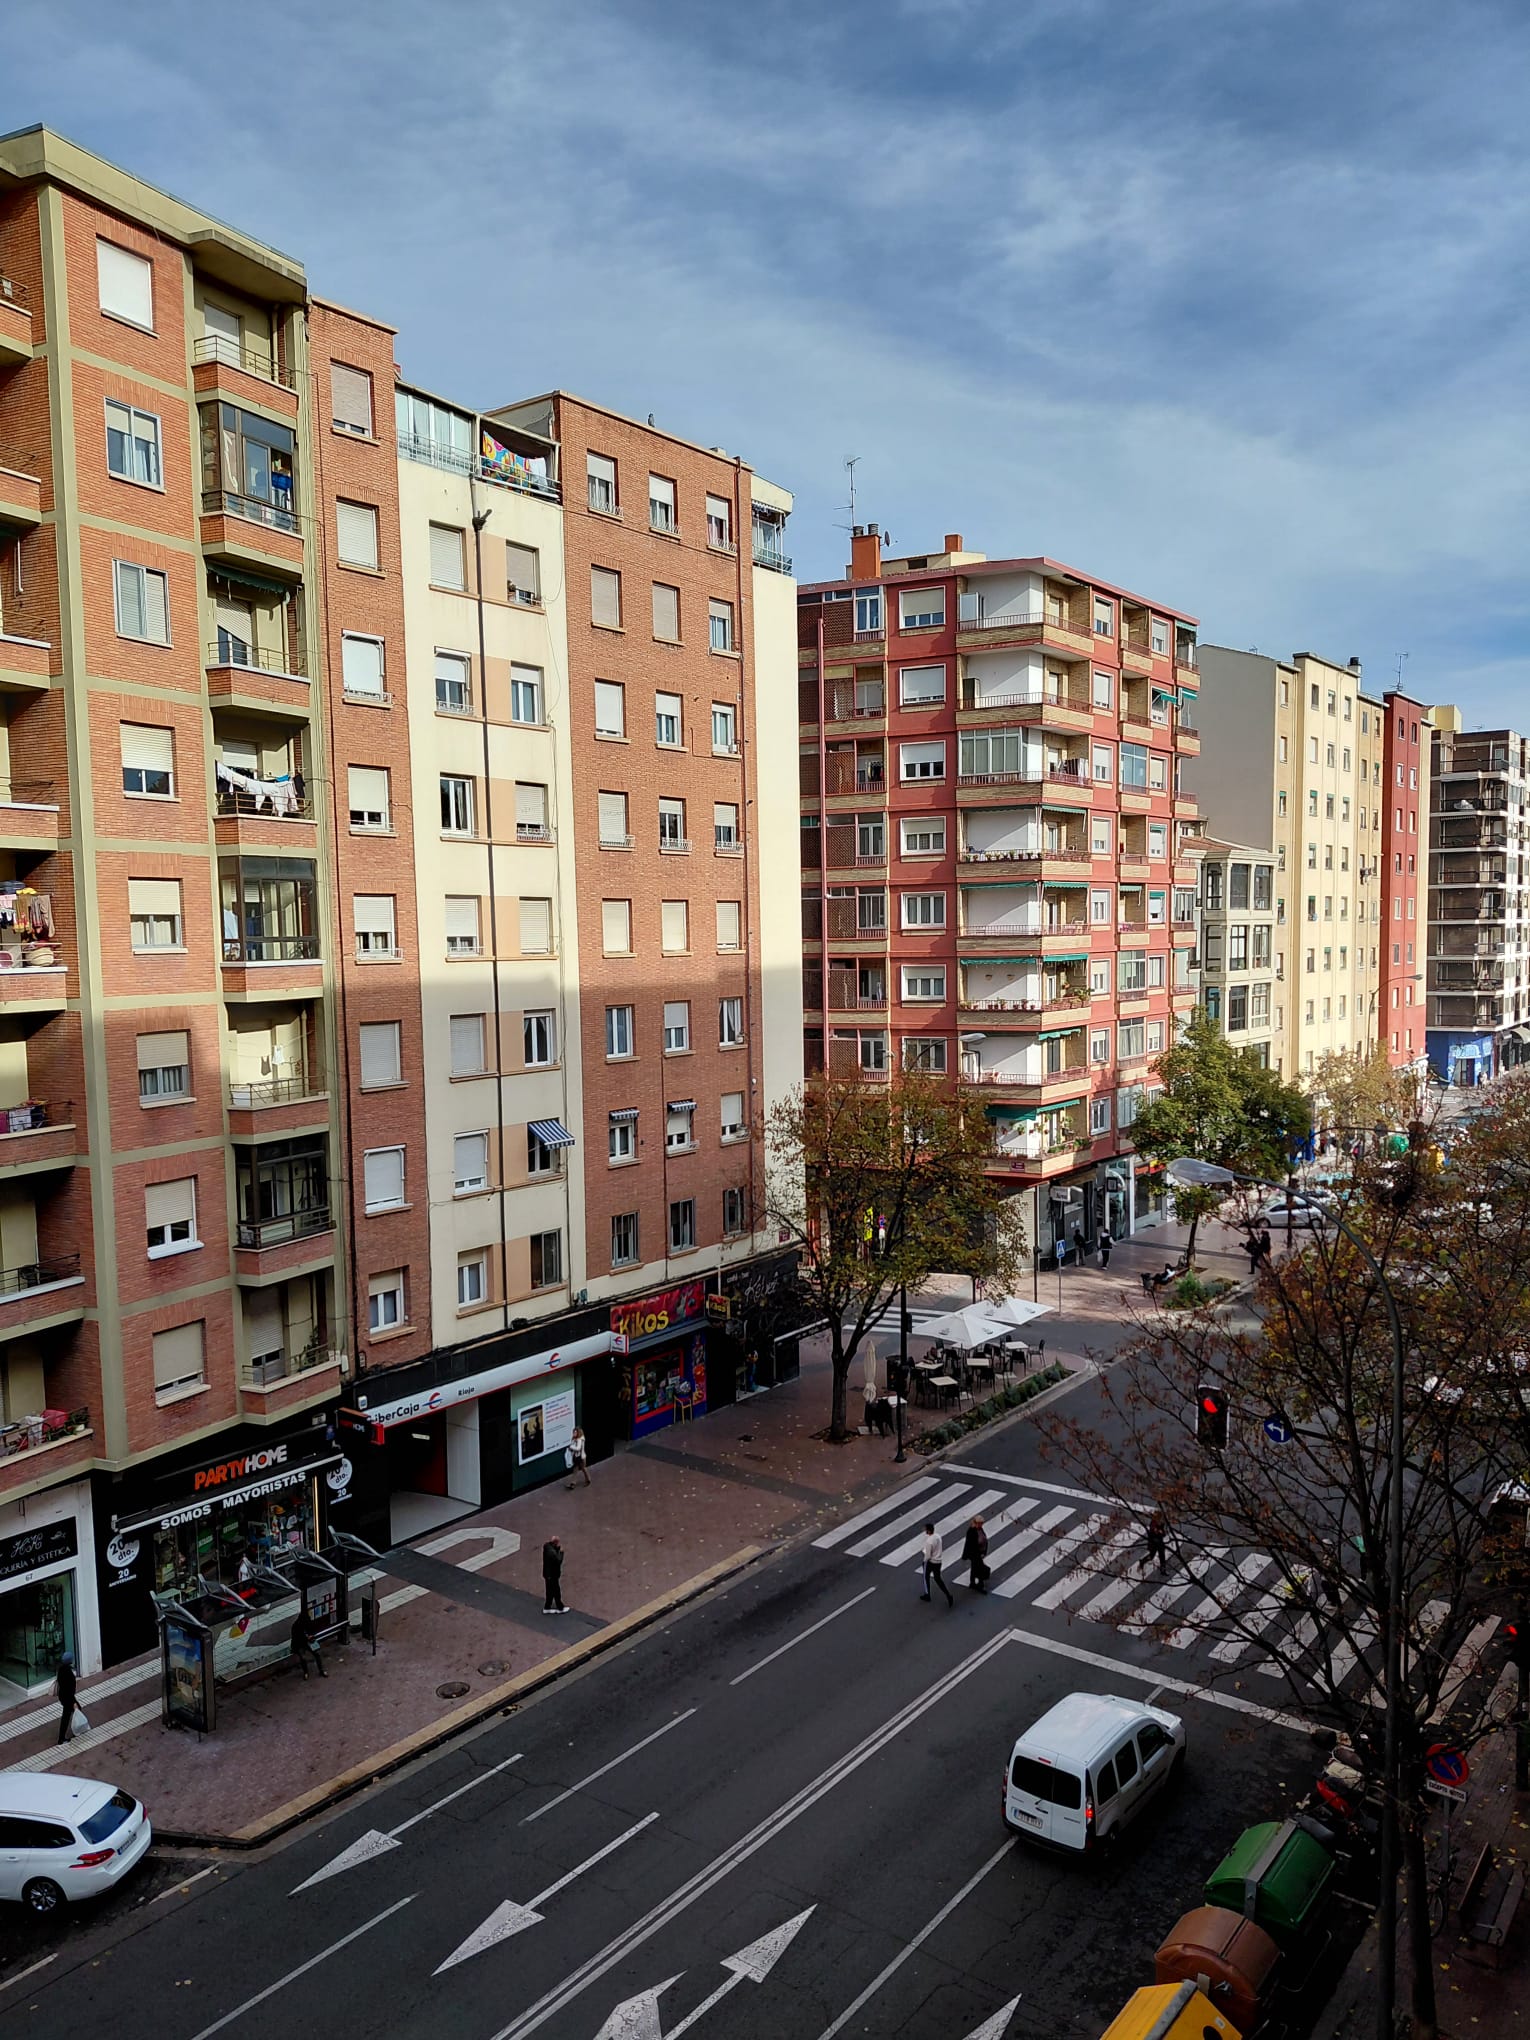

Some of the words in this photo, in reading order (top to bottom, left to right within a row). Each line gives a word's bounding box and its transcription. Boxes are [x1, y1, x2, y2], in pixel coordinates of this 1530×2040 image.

[619, 1310, 669, 1339] Kikos
[193, 1444, 288, 1491] PARTYHOME
[160, 1504, 212, 1530] SOMOS
[222, 1471, 307, 1509] MAYORISTAS
[118, 1568, 129, 1579] 20
